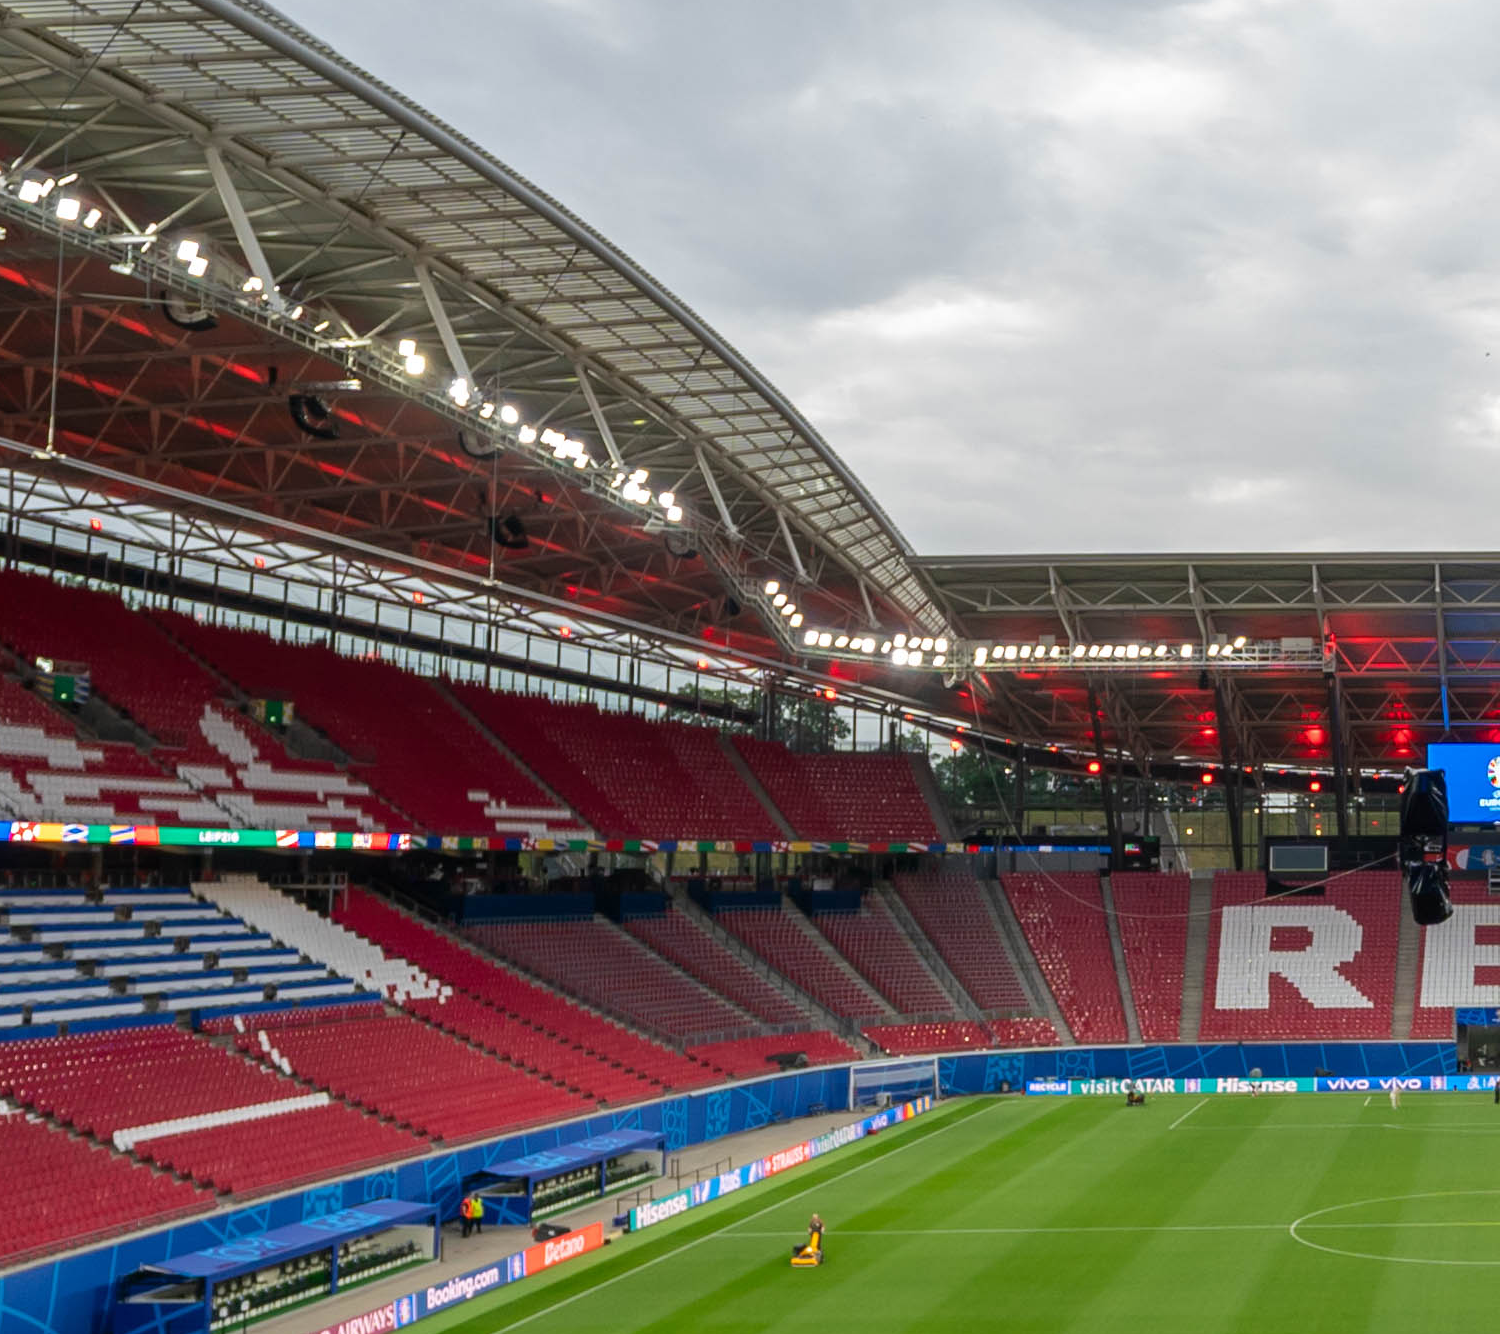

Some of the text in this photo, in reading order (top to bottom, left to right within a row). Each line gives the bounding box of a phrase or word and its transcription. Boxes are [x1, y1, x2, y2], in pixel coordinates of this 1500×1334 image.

[1327, 1076, 1422, 1090] vivo vivo
[771, 1145, 804, 1172] STRAUSS
[636, 1191, 688, 1228] Hisense
[544, 1232, 585, 1266] Betano
[427, 1265, 499, 1310] Booking.com
